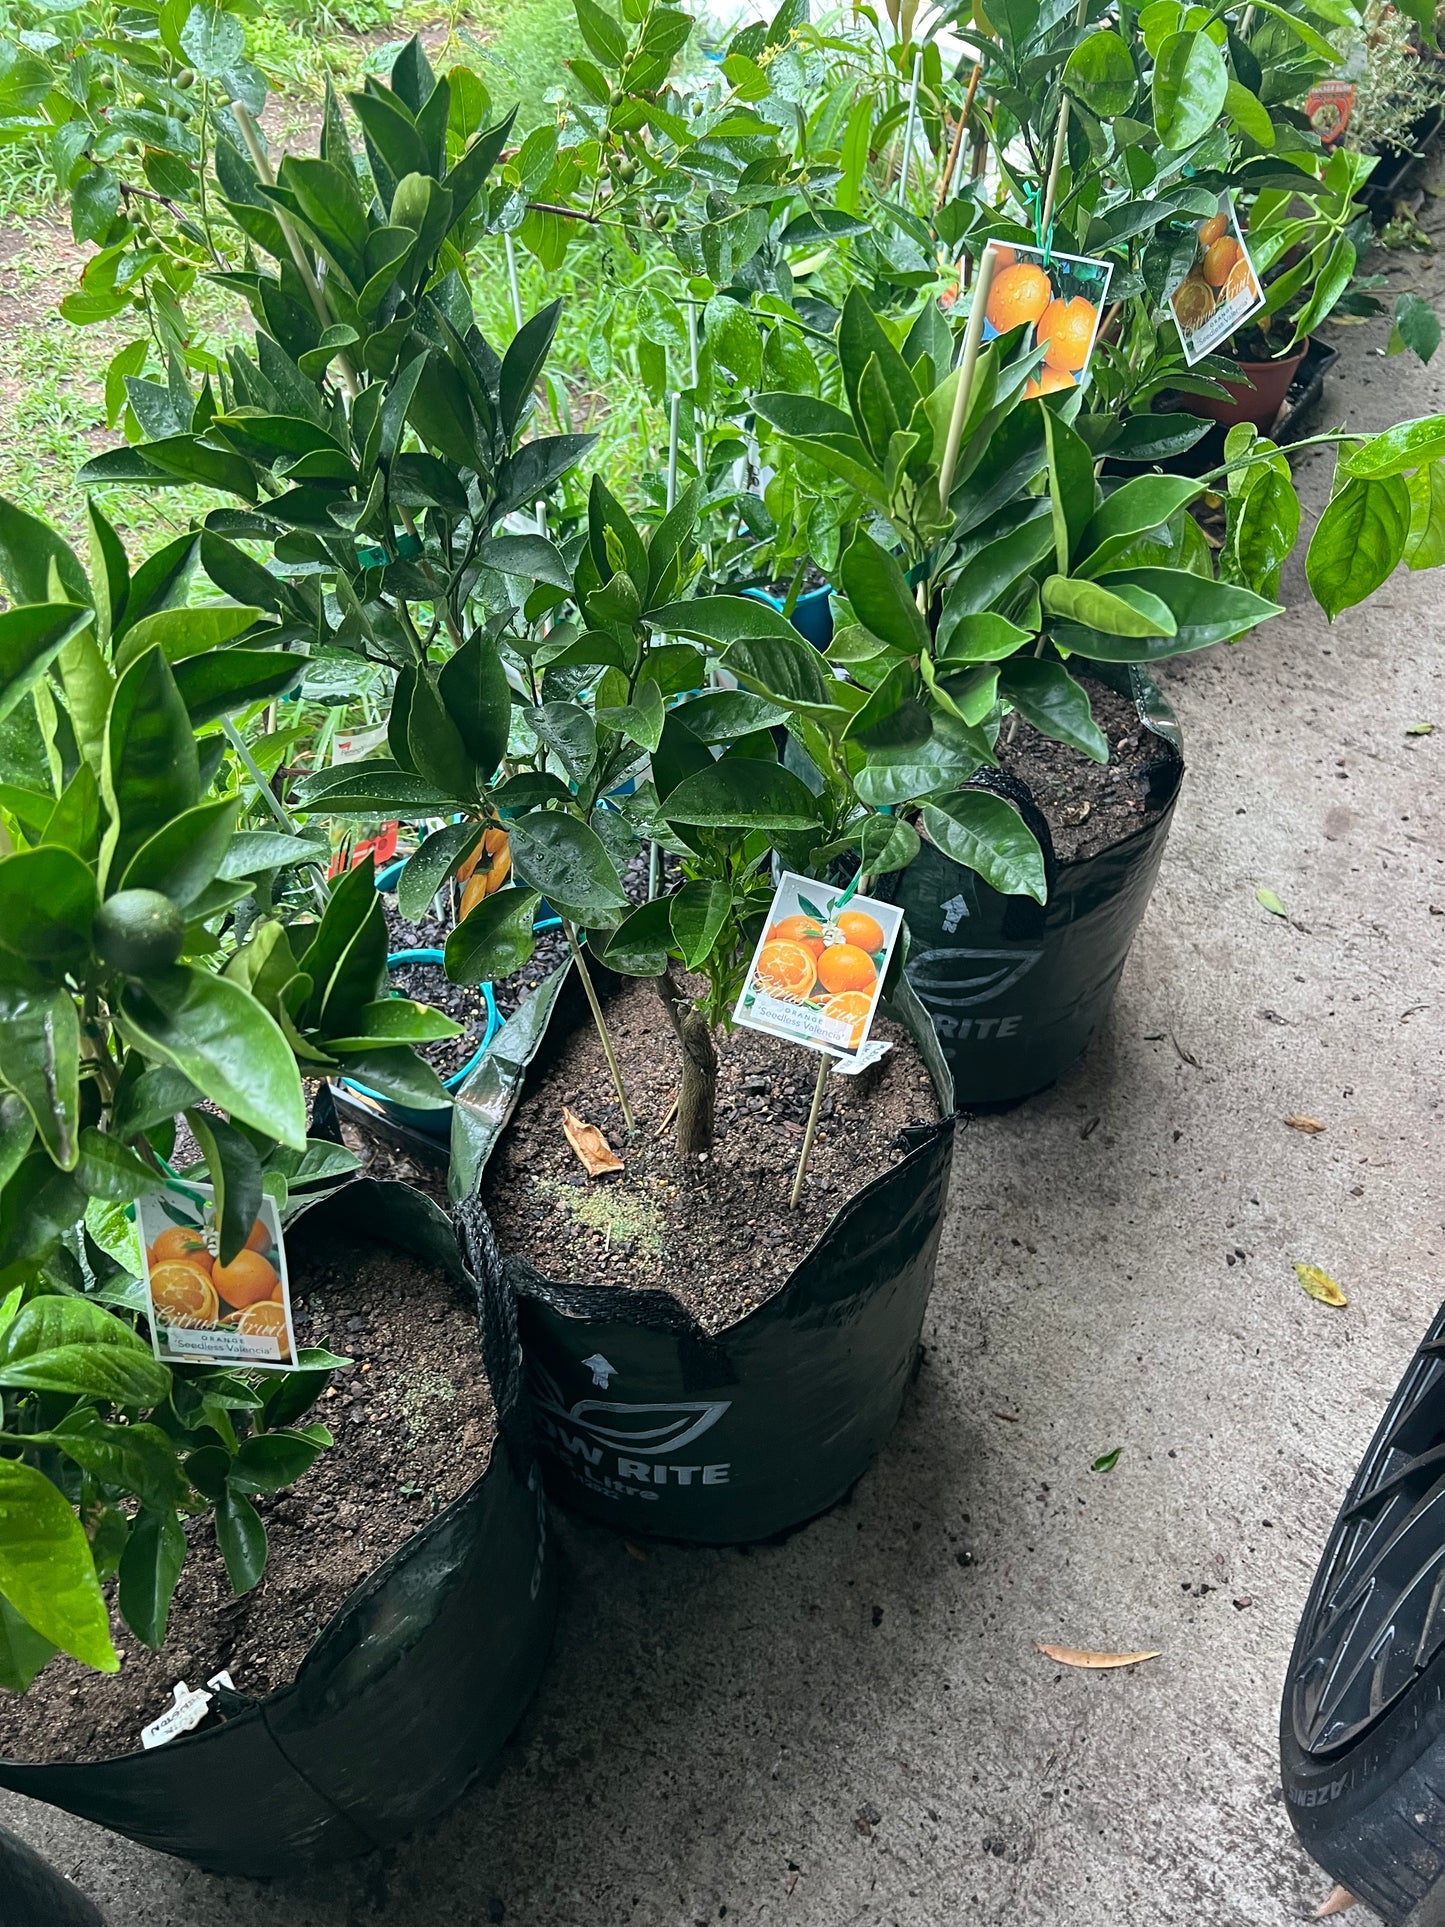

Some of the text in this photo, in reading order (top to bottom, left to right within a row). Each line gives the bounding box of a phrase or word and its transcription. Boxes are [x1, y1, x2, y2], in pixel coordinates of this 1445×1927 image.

[1219, 270, 1250, 301] Fruit
[1210, 305, 1232, 328] ORANGE
[751, 971, 867, 1025] Citrus Fruit
[784, 1007, 824, 1025] ORANGE
[932, 1013, 1023, 1039] RITE
[153, 1303, 287, 1338] Citrus Fruit
[201, 1335, 245, 1344] ORANGE
[617, 1456, 732, 1486] RITE
